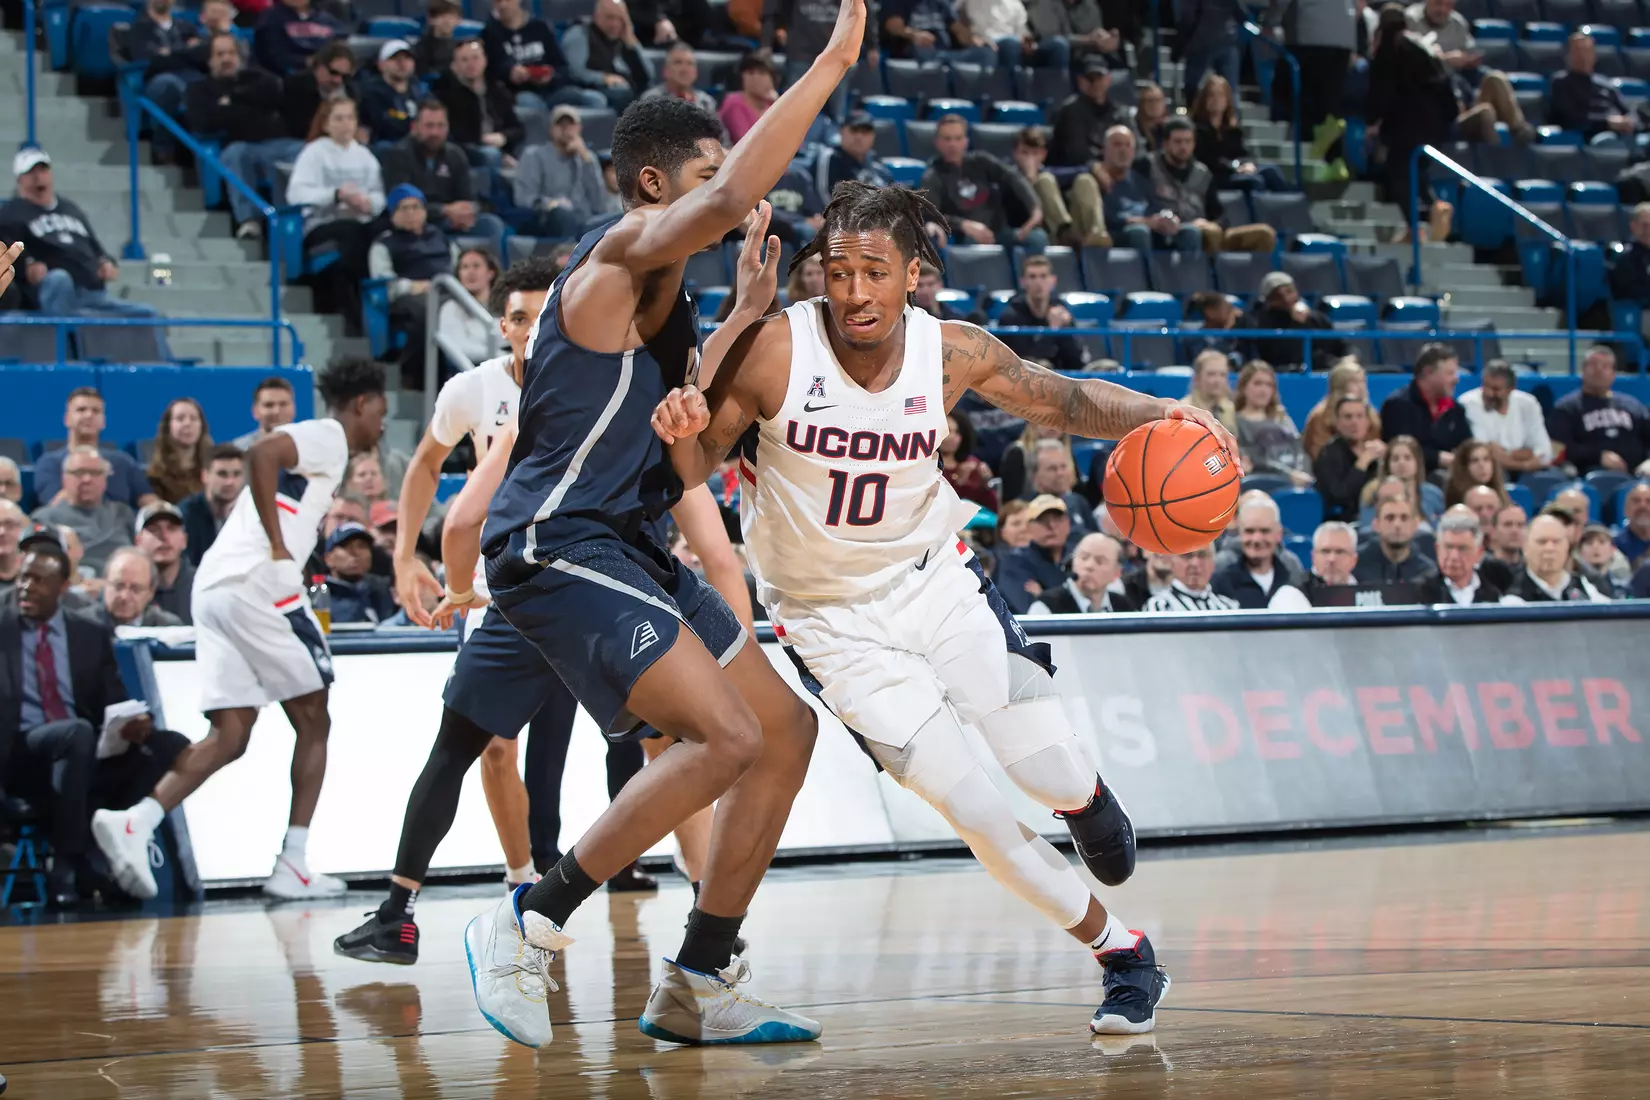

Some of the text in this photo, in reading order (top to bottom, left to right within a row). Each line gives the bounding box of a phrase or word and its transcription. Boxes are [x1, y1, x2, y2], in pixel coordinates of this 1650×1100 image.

[786, 419, 937, 462] UCONN
[825, 468, 891, 527] 10
[1180, 676, 1643, 765] DECEMBER
